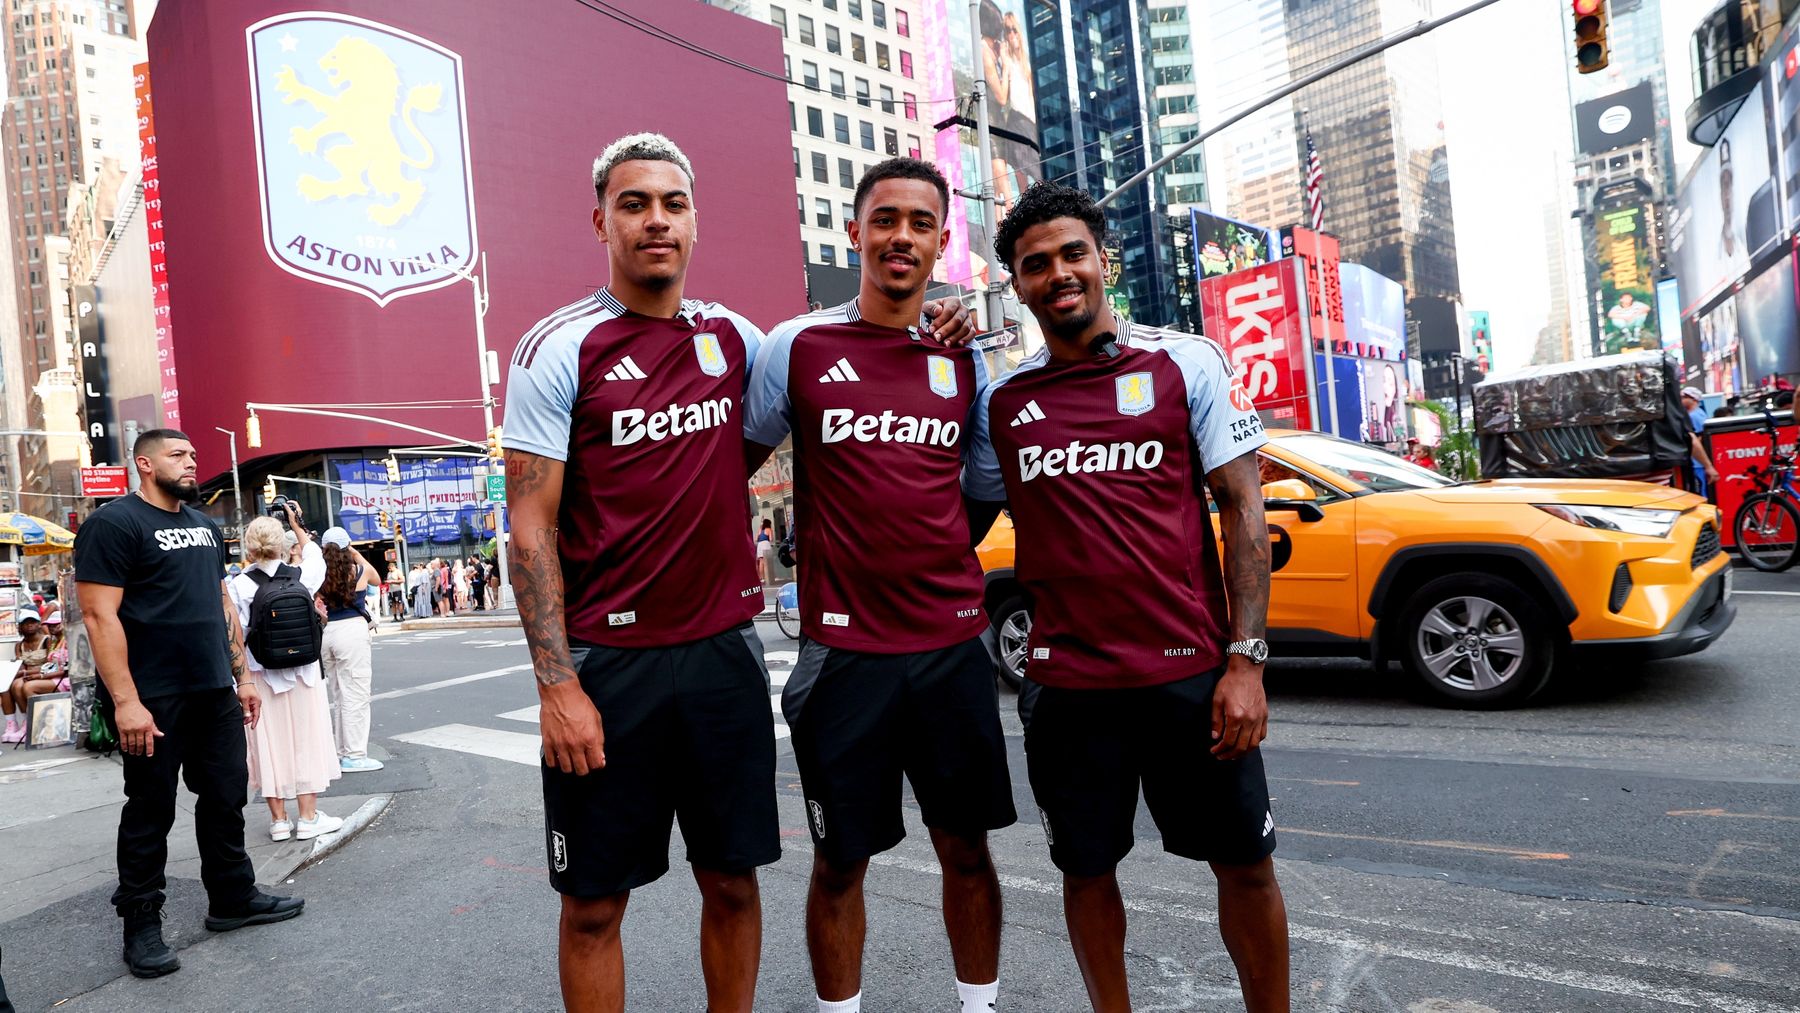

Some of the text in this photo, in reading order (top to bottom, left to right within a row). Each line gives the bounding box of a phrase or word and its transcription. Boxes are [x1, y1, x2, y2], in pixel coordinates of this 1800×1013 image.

[286, 235, 460, 276] ASTON VILLA
[996, 333, 1011, 344] WAY
[1226, 273, 1285, 400] tkts
[612, 397, 732, 446] Betano
[822, 408, 960, 447] Betano
[1018, 440, 1164, 482] Betano
[1726, 446, 1766, 459] TONY
[154, 527, 217, 551] SECURITY
[1164, 648, 1196, 656] HEAT.RDY
